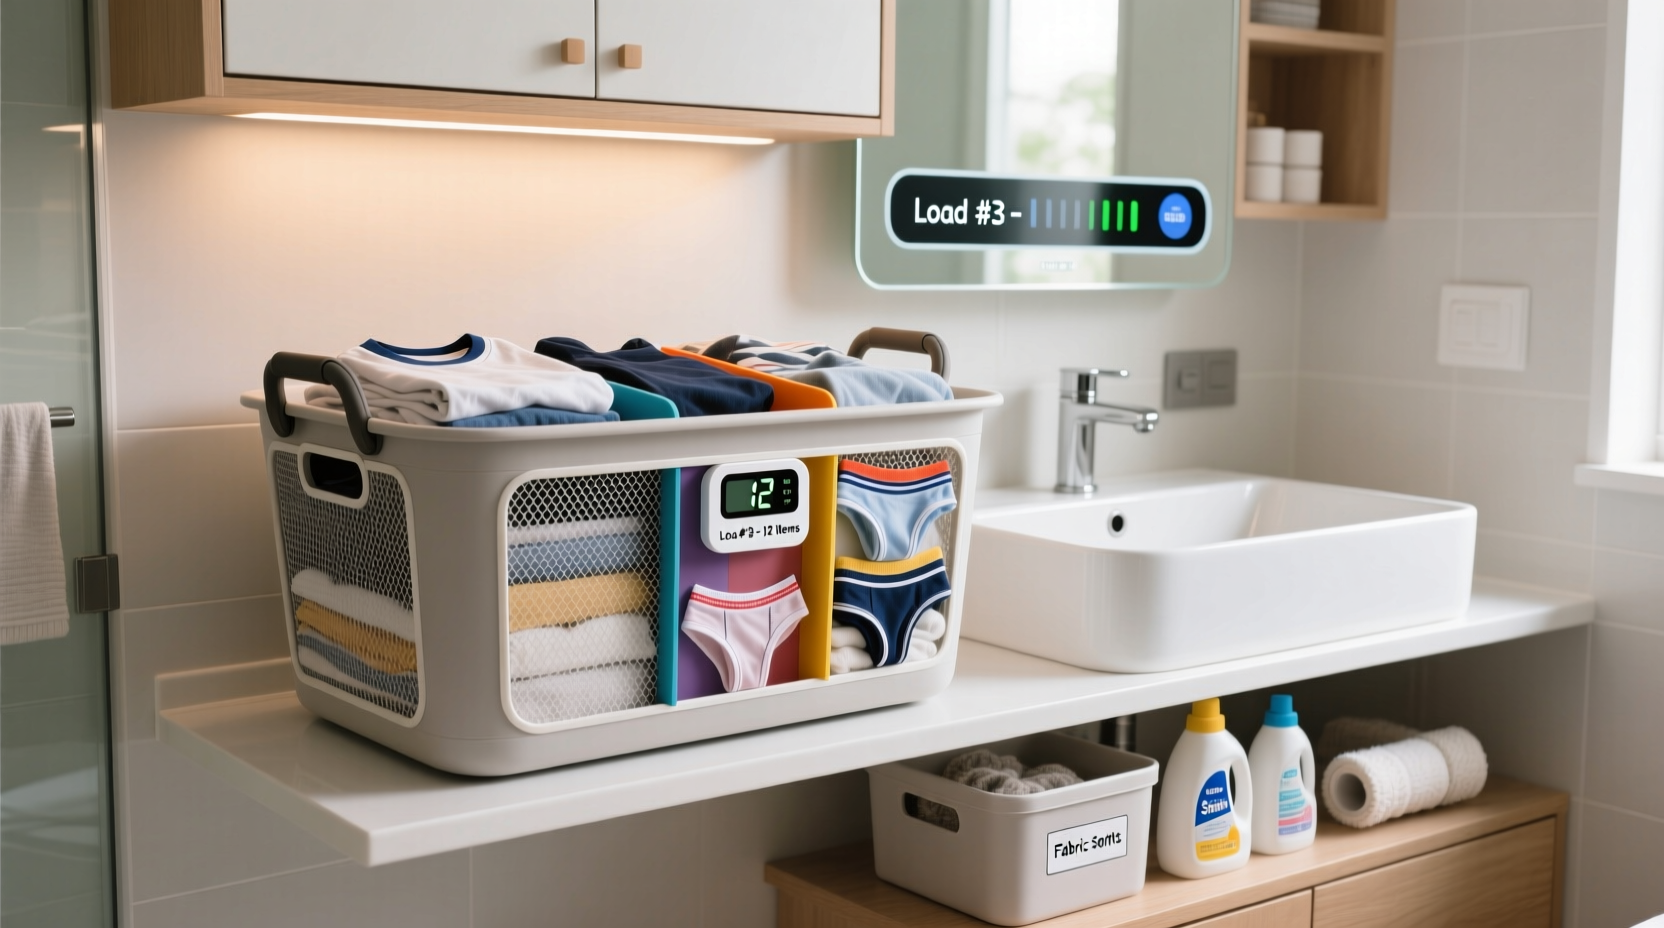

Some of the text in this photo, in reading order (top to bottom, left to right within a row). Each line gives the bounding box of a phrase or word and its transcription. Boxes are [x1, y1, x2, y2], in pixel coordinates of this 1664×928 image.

[914, 197, 968, 224] Load
[750, 478, 775, 509] 12
[763, 525, 773, 537] 12
